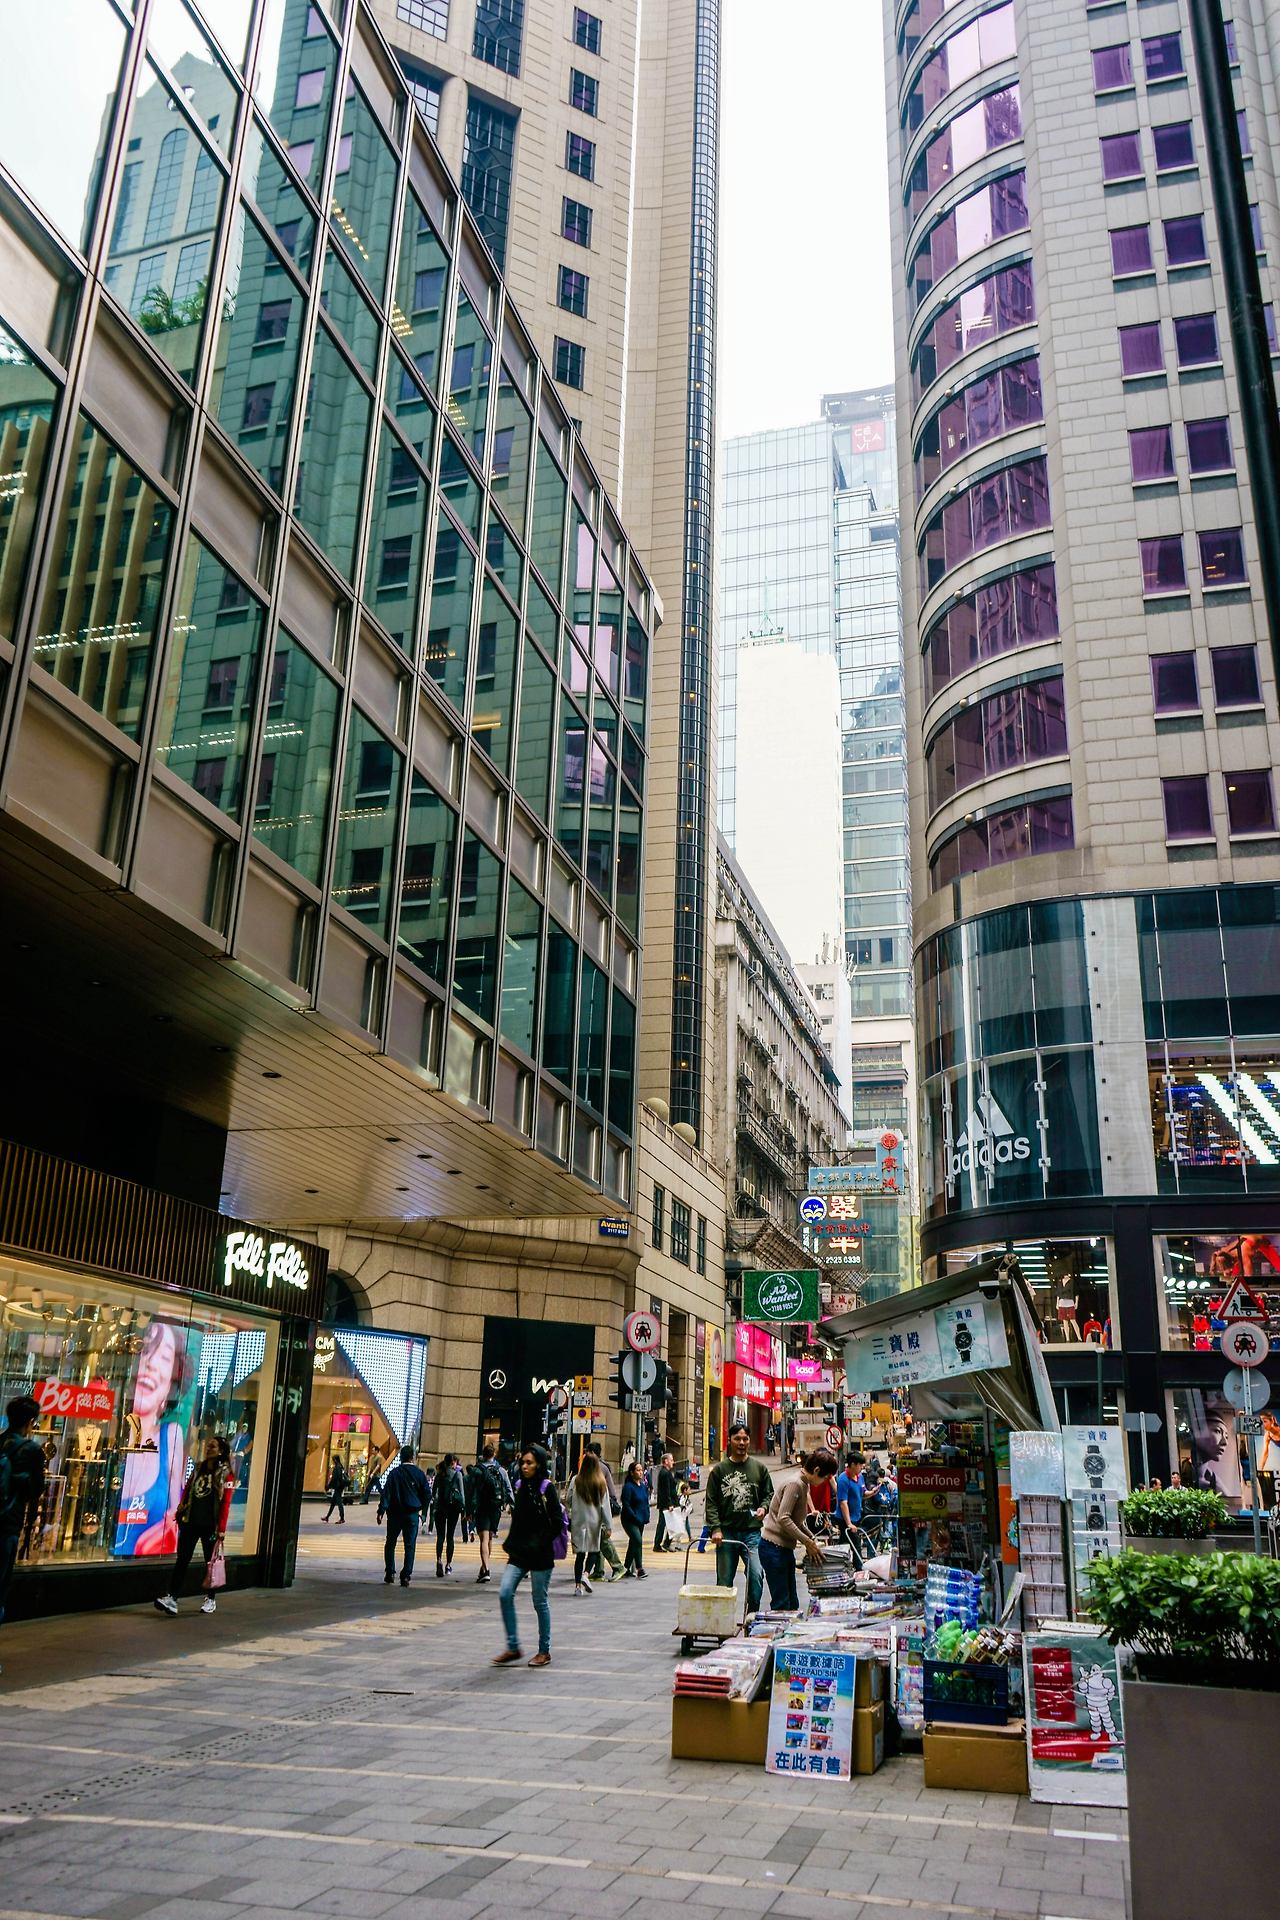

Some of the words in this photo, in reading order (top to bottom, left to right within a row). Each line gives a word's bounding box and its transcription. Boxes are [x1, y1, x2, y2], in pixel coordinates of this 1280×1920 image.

[952, 1136, 1031, 1176] adidas
[600, 1220, 628, 1230] Avanti
[224, 1231, 266, 1286] Folli
[266, 1242, 309, 1290] Follie
[770, 1284, 788, 1295] AD
[762, 1290, 799, 1305] Wanted
[40, 1376, 74, 1412] Be
[904, 1474, 960, 1486] SmarTone
[129, 1497, 146, 1510] Be
[791, 1667, 822, 1676] PREPAID
[775, 1752, 841, 1775] 在此有售
